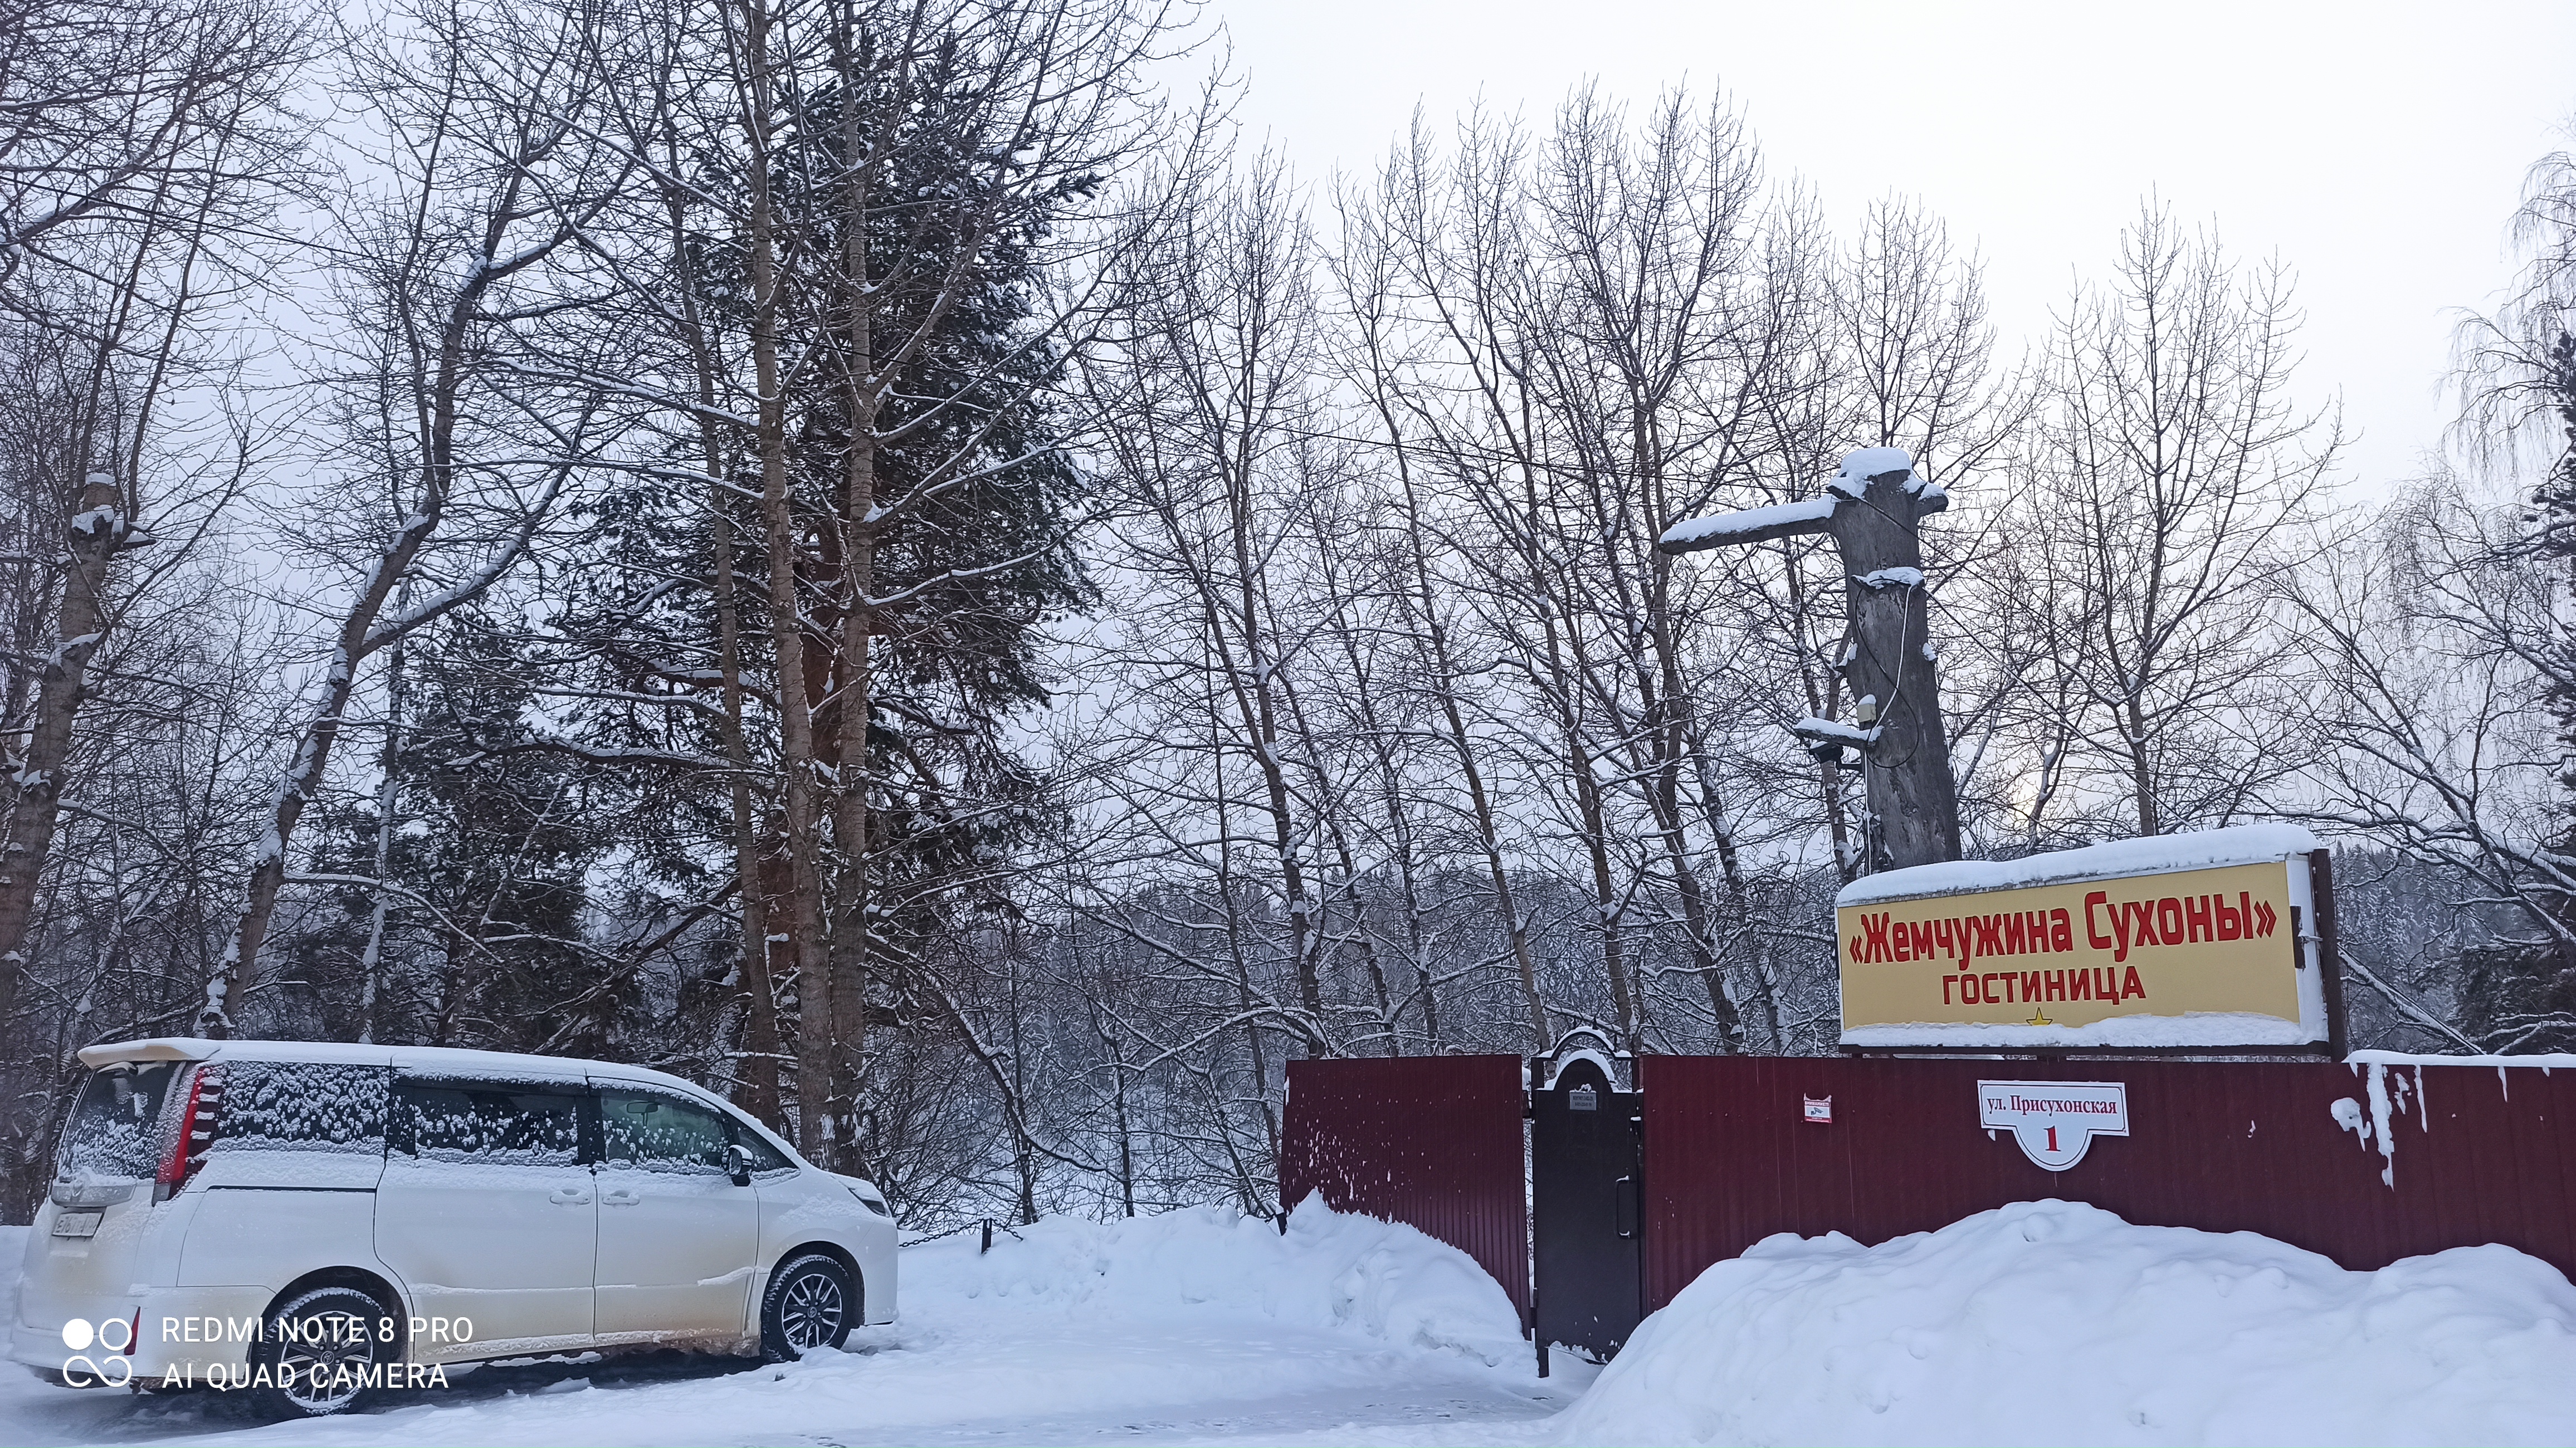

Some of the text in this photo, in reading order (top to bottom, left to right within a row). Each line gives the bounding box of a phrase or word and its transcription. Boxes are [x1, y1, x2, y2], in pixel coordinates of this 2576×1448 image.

[1848, 891, 2277, 971] «Жемчужина Сухоны»
[1943, 967, 2145, 1005] ГОСТИНИЦА
[1987, 1095, 2117, 1116] ул. Присухонская
[2043, 1125, 2061, 1152] 1
